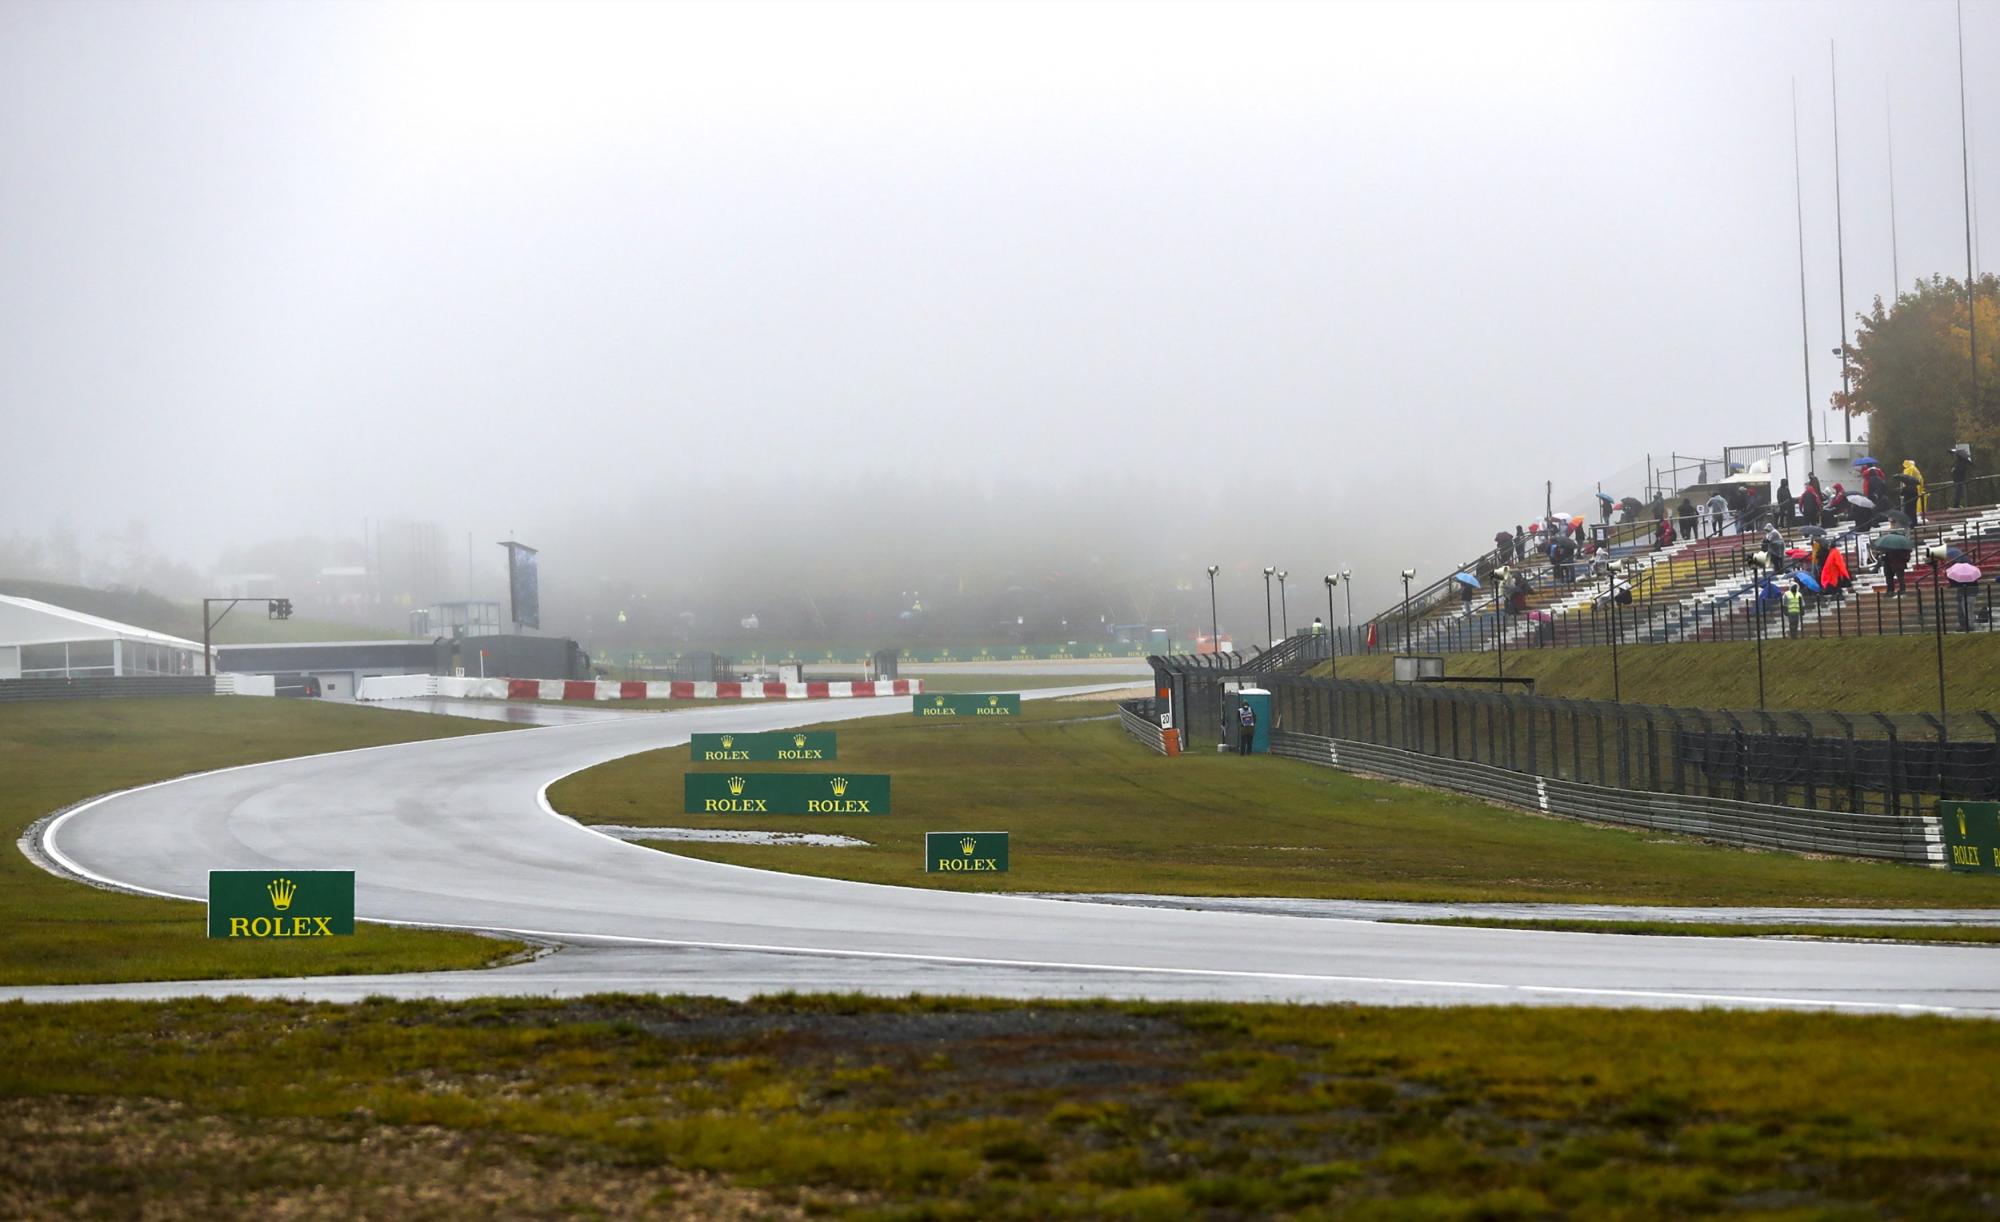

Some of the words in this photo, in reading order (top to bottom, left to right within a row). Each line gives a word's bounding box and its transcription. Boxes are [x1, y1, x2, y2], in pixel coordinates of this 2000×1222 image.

[923, 707, 956, 716] ROLEX
[976, 707, 1010, 715] ROLEX
[1162, 715, 1170, 725] 20
[705, 751, 750, 761] ROLEX
[778, 749, 823, 760] ROLEX
[705, 799, 768, 812] ROLEX
[808, 800, 870, 813] ROLEX
[1953, 846, 1980, 866] ROLEX
[938, 858, 998, 871] ROLEX
[229, 916, 334, 937] ROLEX
